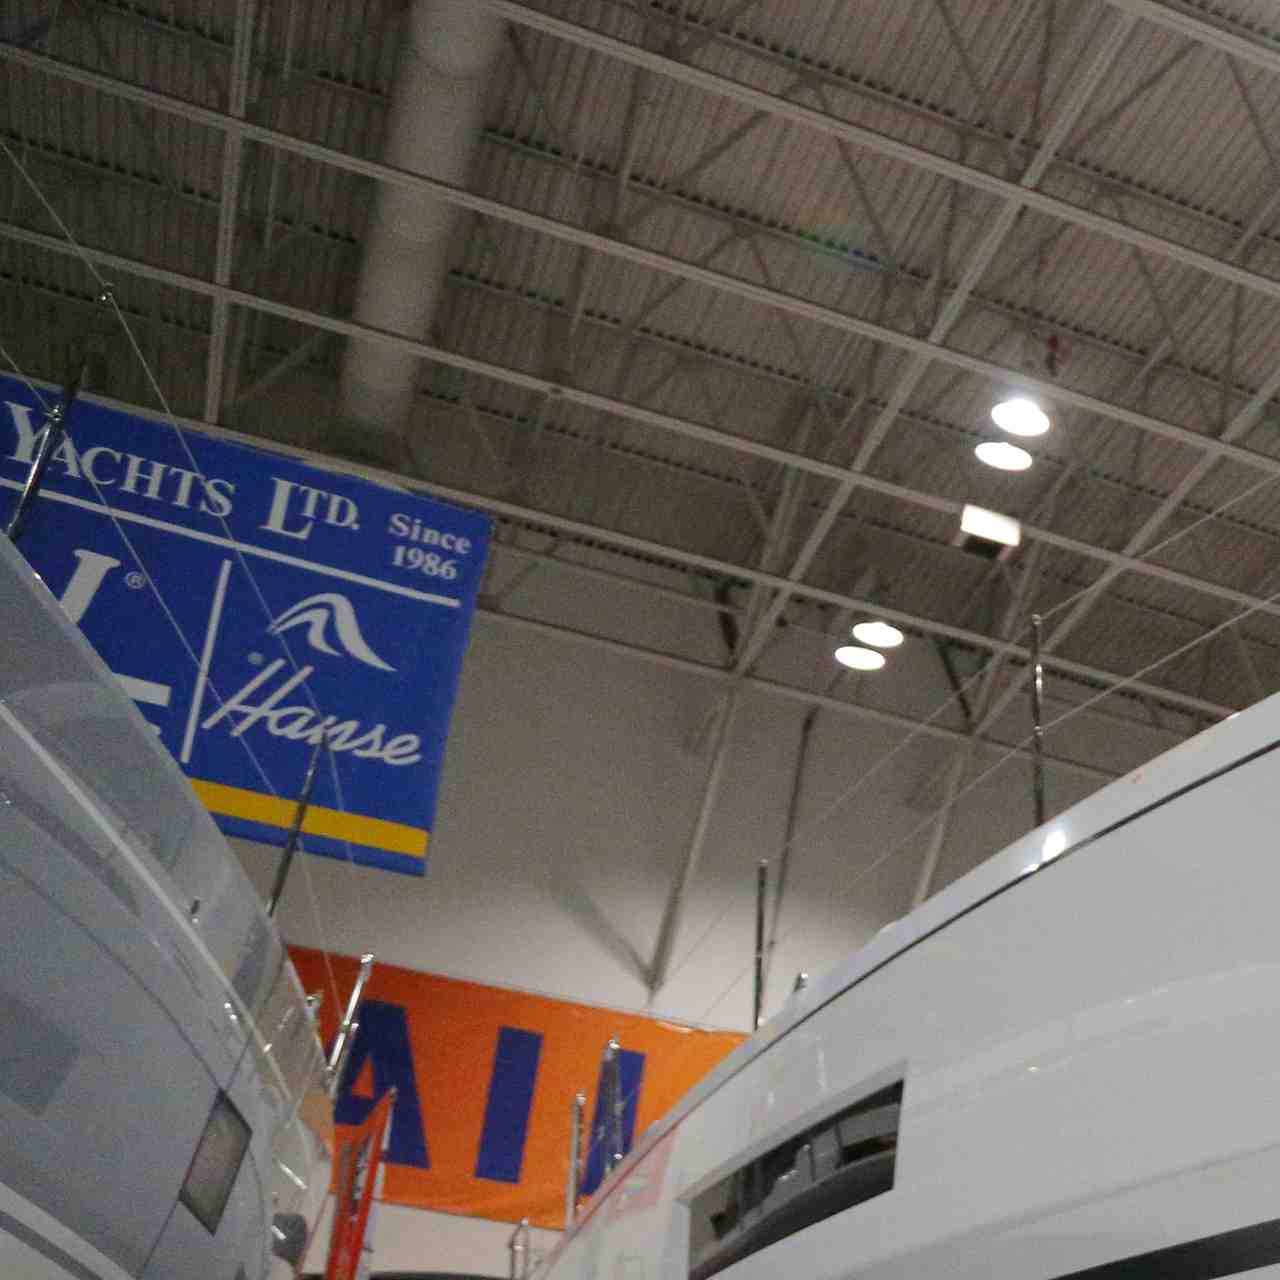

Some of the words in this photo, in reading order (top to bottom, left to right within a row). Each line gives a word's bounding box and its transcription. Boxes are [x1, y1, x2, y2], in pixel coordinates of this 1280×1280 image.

[4, 400, 236, 518] YACHTS
[387, 512, 472, 555] Since
[391, 545, 458, 580] 1986
[202, 657, 422, 766] Hanse
